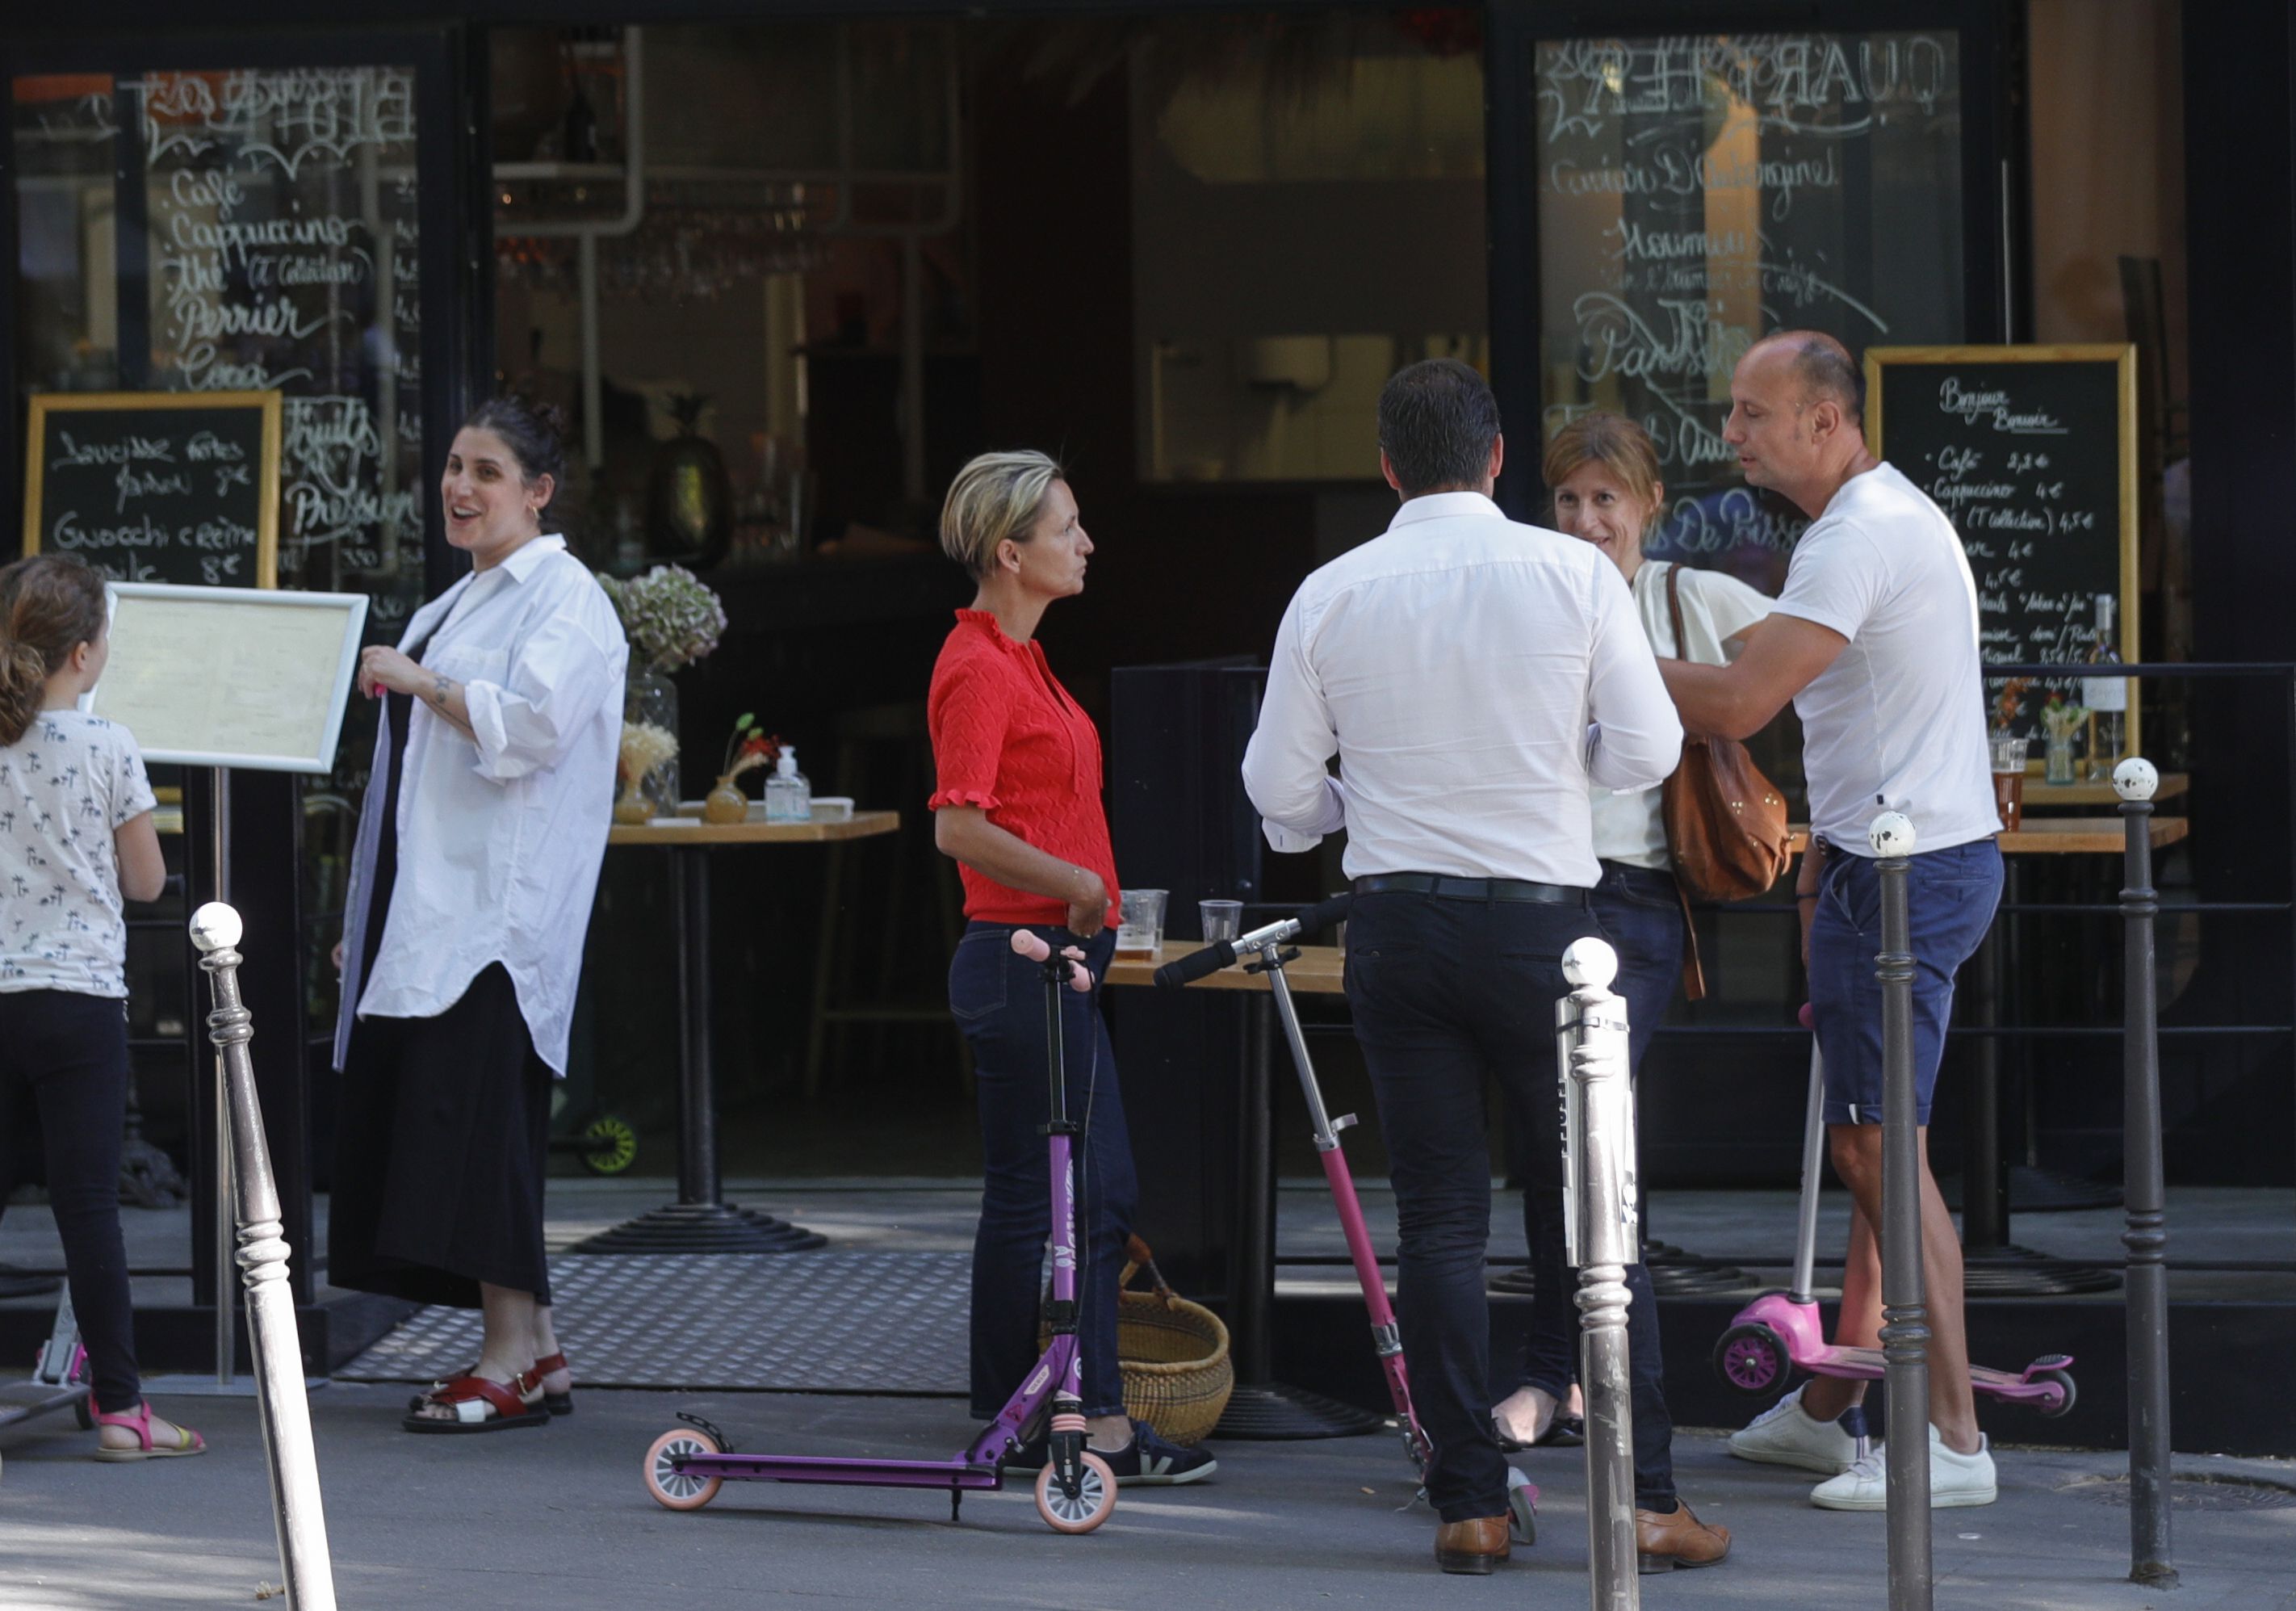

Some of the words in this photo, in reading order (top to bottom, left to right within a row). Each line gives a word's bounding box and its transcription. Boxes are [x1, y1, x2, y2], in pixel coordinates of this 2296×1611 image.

[175, 292, 355, 353] Perrier
[1940, 375, 2010, 426] Bonjour
[1993, 406, 2059, 431] Bonsoir
[1938, 445, 1984, 482] Café
[1934, 480, 2016, 510] Cappuccino
